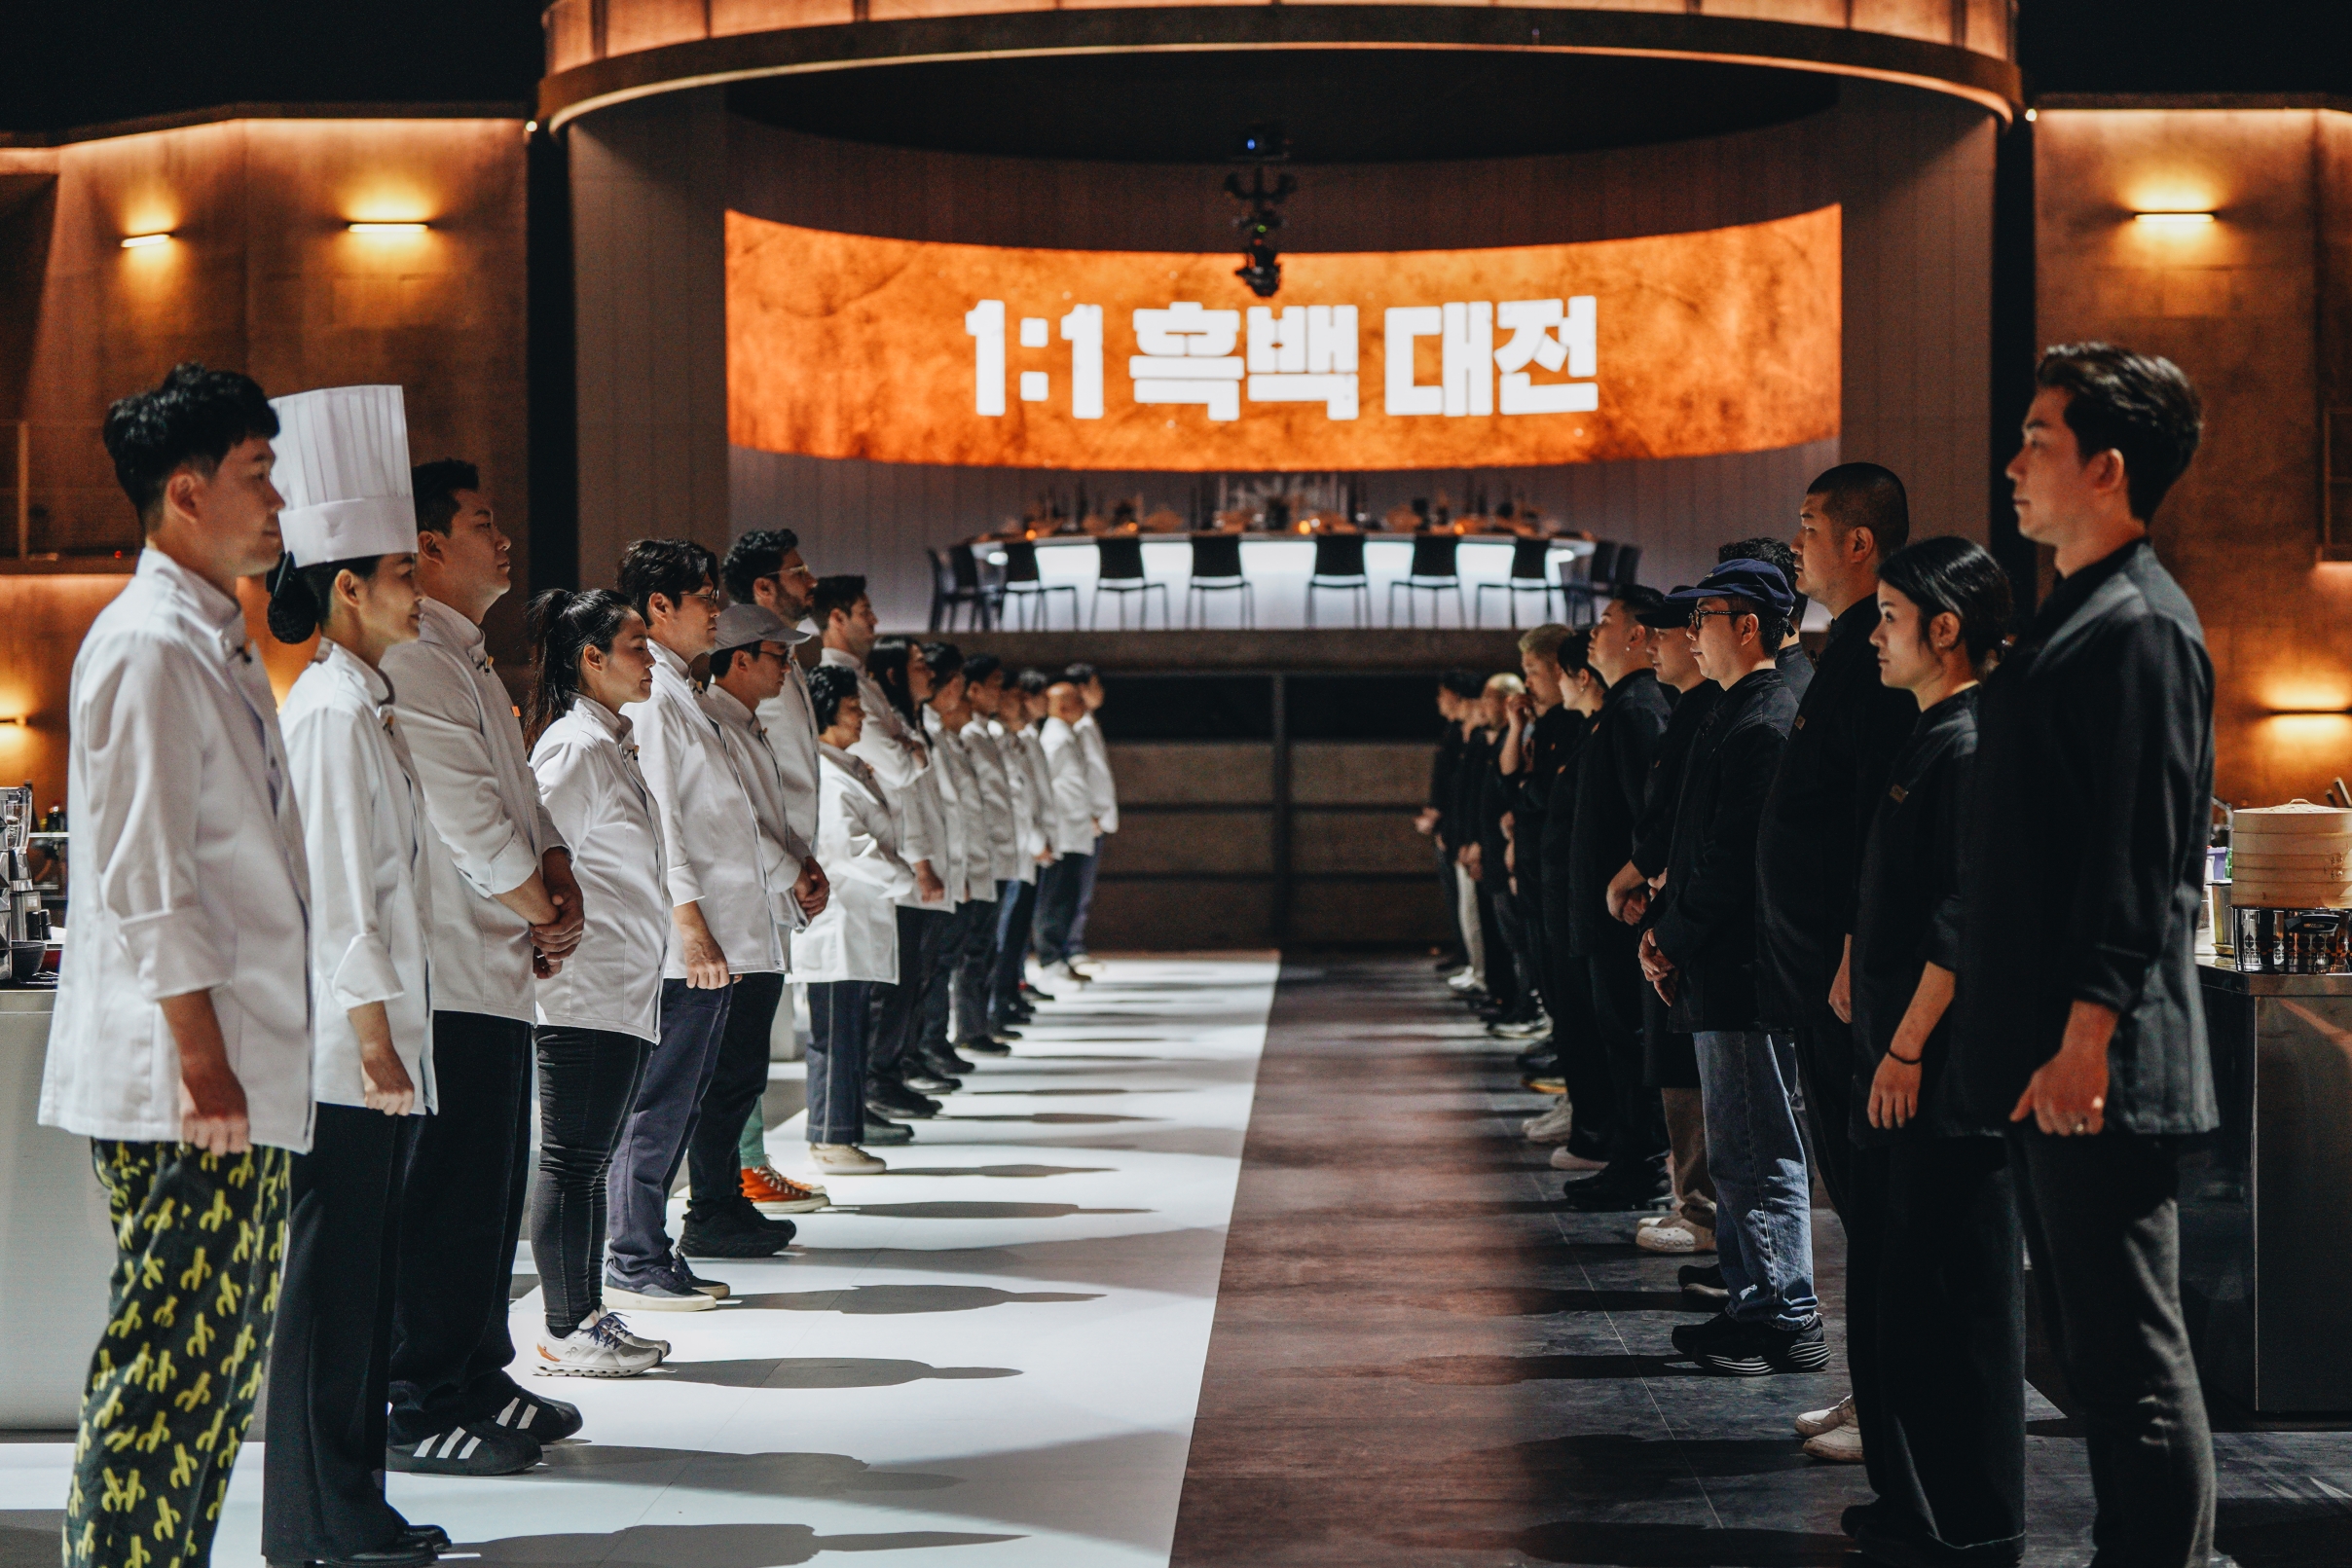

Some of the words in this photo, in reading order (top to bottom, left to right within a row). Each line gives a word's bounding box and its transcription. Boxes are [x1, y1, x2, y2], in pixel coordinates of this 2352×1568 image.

[965, 299, 1103, 419] 1:1
[1129, 302, 1358, 420] 흑백
[1384, 295, 1599, 416] 대전
